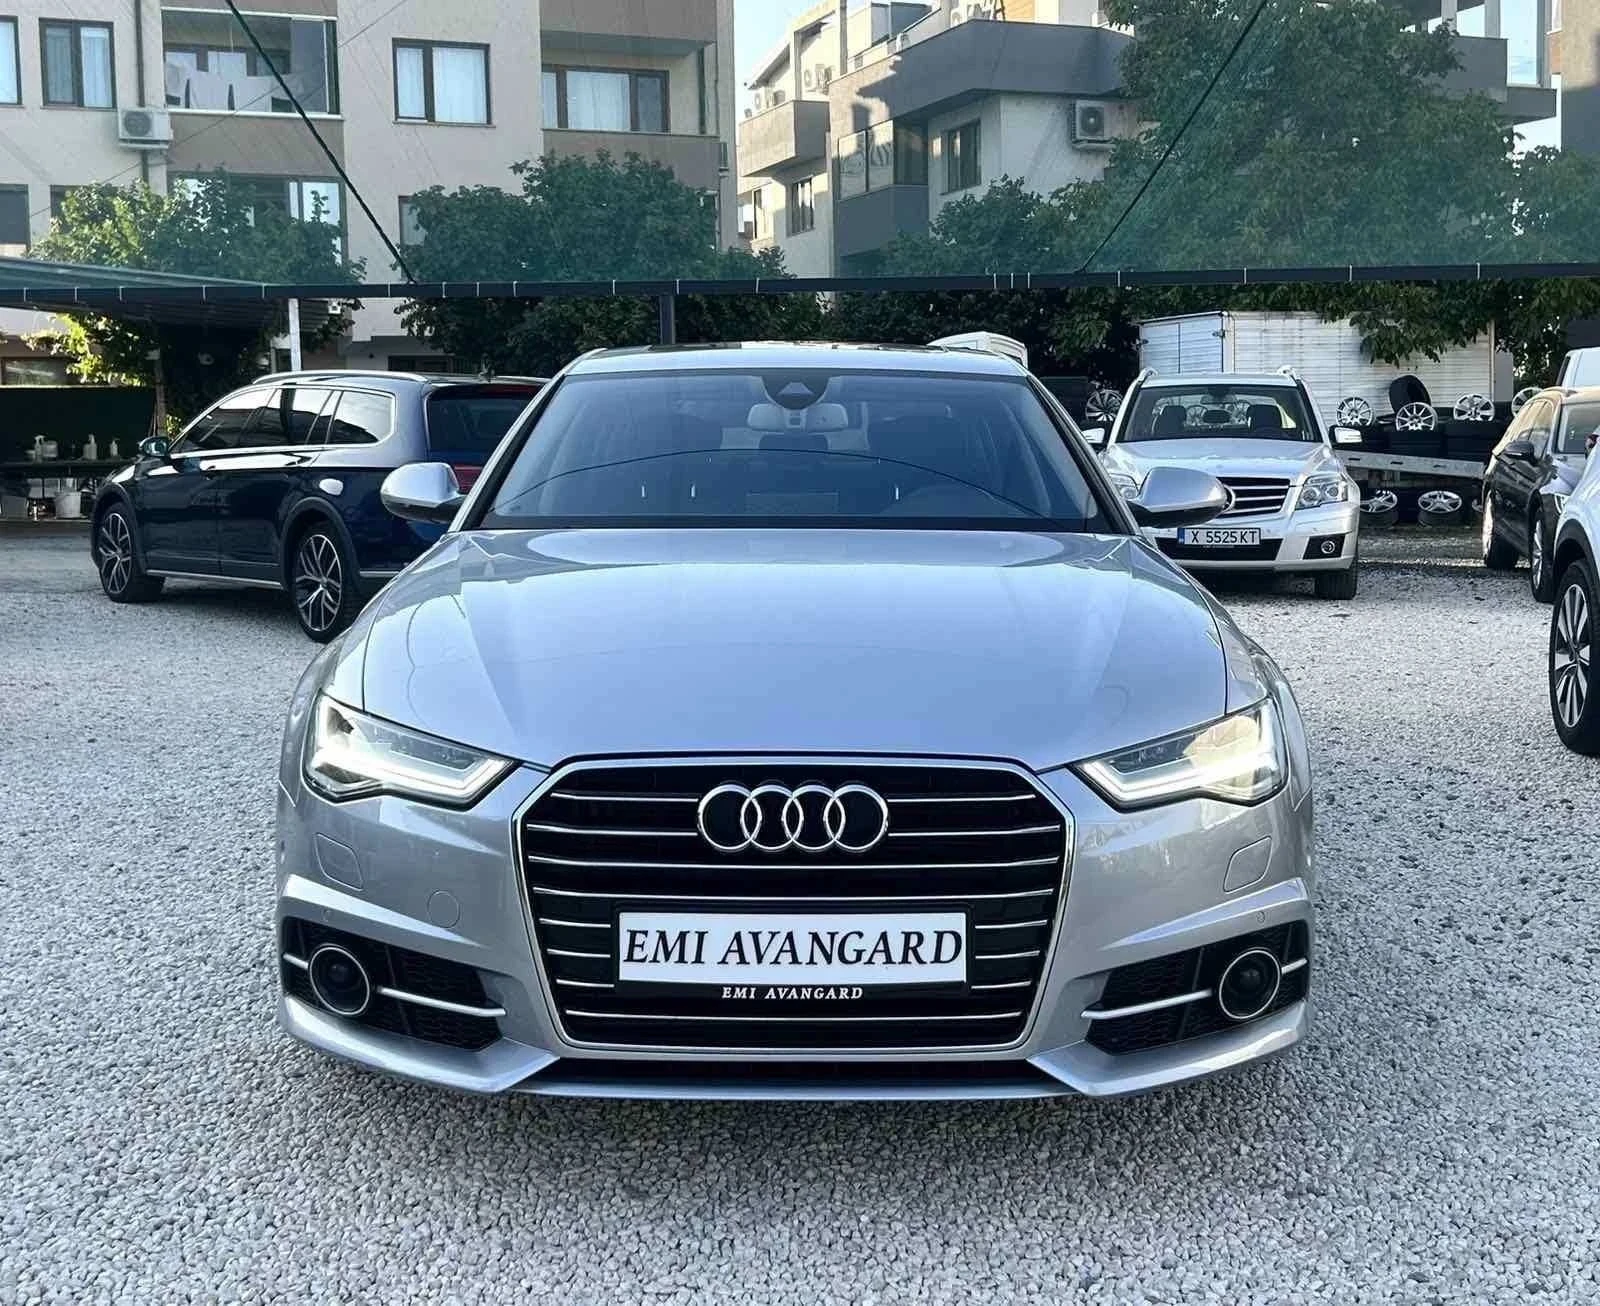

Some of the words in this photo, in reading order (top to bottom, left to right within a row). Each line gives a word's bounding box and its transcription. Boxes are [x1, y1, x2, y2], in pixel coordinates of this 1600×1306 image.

[1191, 531, 1199, 543] X
[623, 929, 709, 964] EMI
[717, 930, 963, 965] AVANGARD
[721, 986, 756, 999] EMI
[765, 986, 863, 999] AVANGARD
